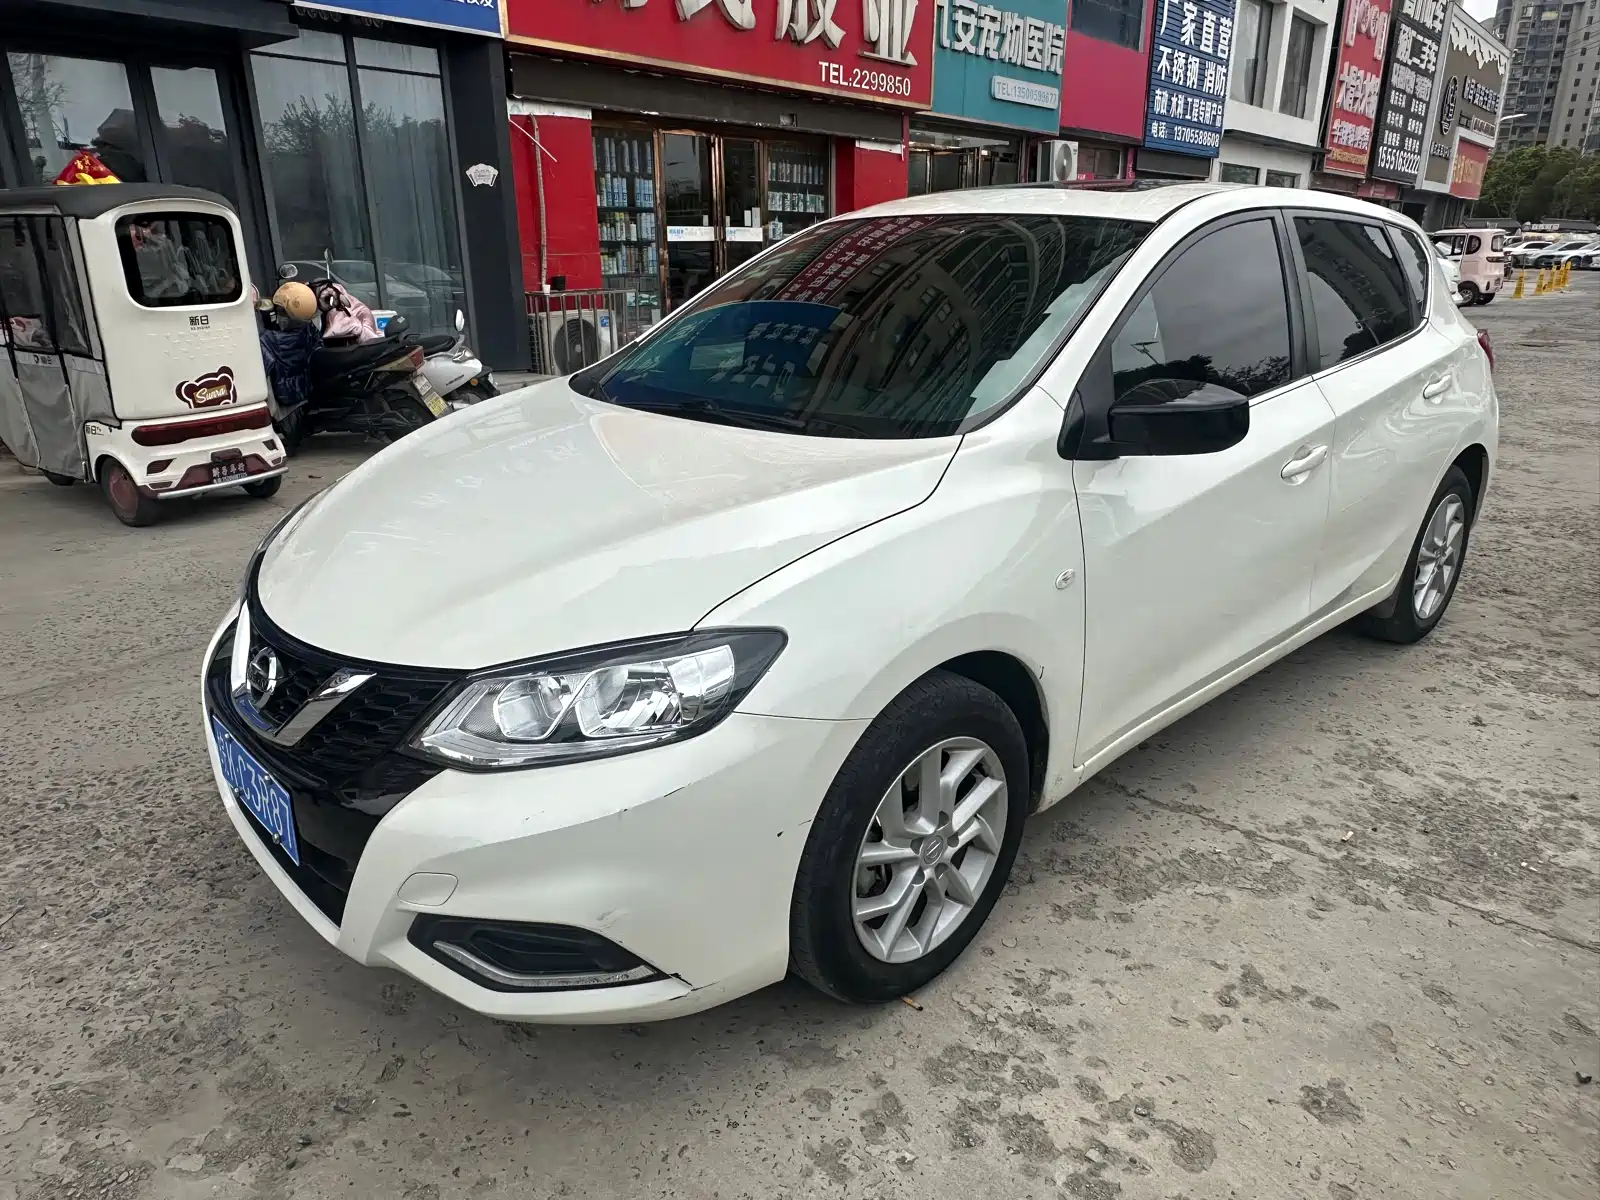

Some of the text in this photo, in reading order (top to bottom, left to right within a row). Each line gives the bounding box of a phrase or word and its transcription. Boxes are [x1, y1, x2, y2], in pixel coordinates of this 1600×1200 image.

[1160, 0, 1232, 59] 厂家直营
[818, 61, 911, 96] TEL:2299850
[1157, 45, 1228, 97] 不锈钢 消防
[1170, 93, 1185, 119] 水利
[1185, 97, 1223, 127] 工程专用产品
[189, 315, 209, 326] 新日
